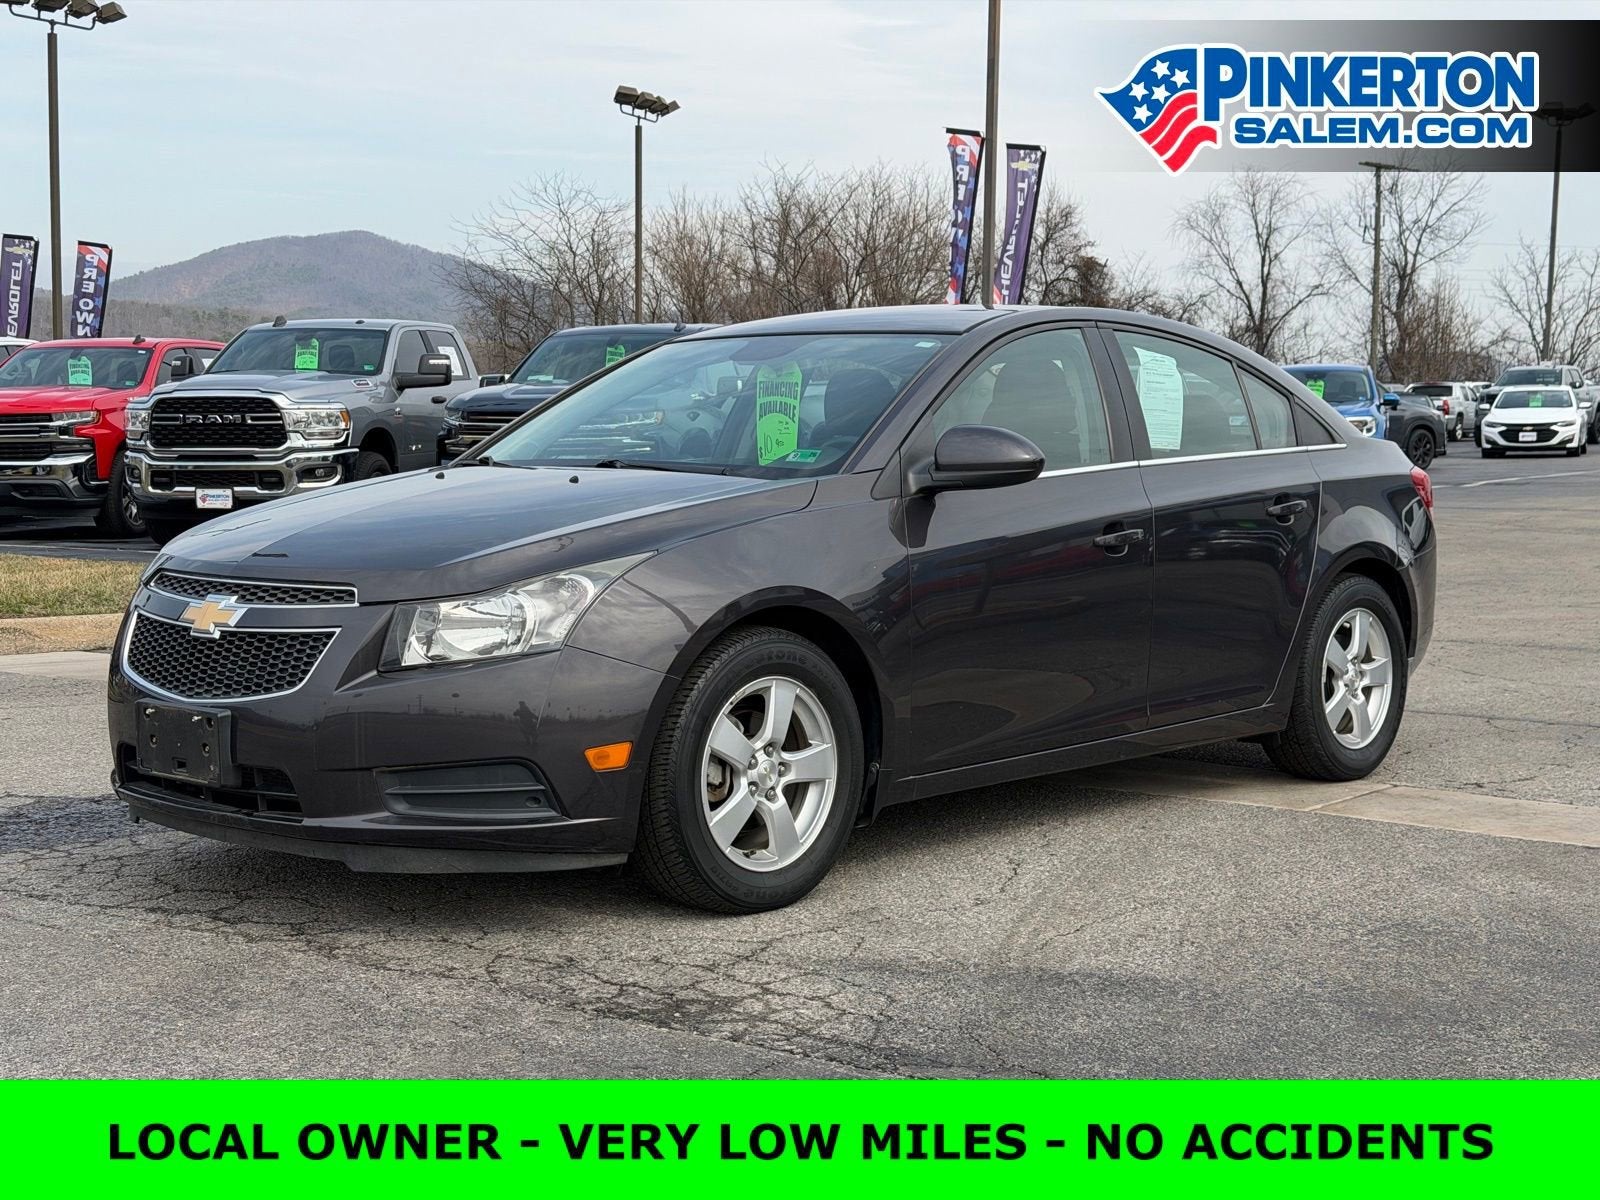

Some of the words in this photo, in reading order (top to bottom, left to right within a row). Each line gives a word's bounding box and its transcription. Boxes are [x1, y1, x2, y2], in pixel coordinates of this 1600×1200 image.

[758, 381, 799, 401] FINANCING
[185, 414, 242, 424] RAM
[758, 400, 797, 424] AVAILABLE
